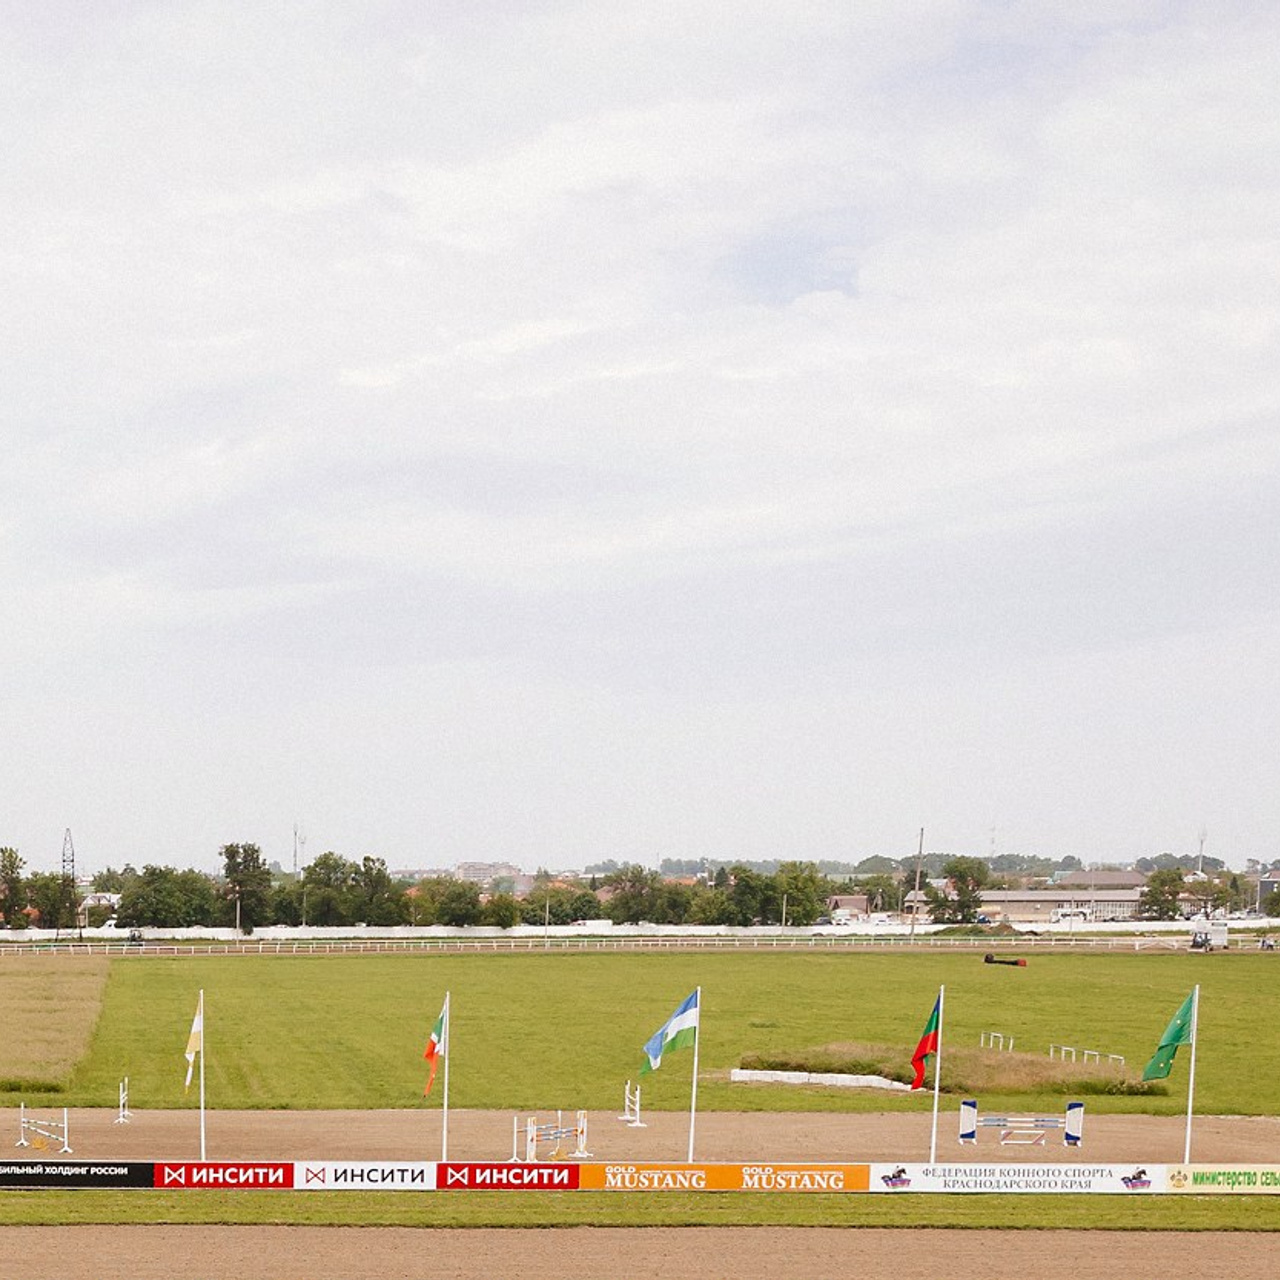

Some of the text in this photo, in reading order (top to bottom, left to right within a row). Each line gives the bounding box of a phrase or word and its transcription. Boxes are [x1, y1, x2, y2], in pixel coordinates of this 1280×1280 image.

[45, 1166, 89, 1177] ХОЛДИНГ
[90, 1167, 128, 1175] РОССИИ
[192, 1167, 284, 1184] ИНСИТИ
[334, 1168, 425, 1184] ИНСИТИ
[475, 1168, 569, 1184] ИНСИТИ
[605, 1165, 636, 1174] GOLD
[742, 1166, 773, 1175] GOLD
[922, 1168, 1113, 1179] ФЕДЕРАЦИЯ КОННОГО СПОРТА
[605, 1173, 706, 1189] MUSTANG
[741, 1174, 844, 1190] MUSTANG
[943, 1178, 1092, 1190] КРАСНОДАРСКОГО КРАЯ
